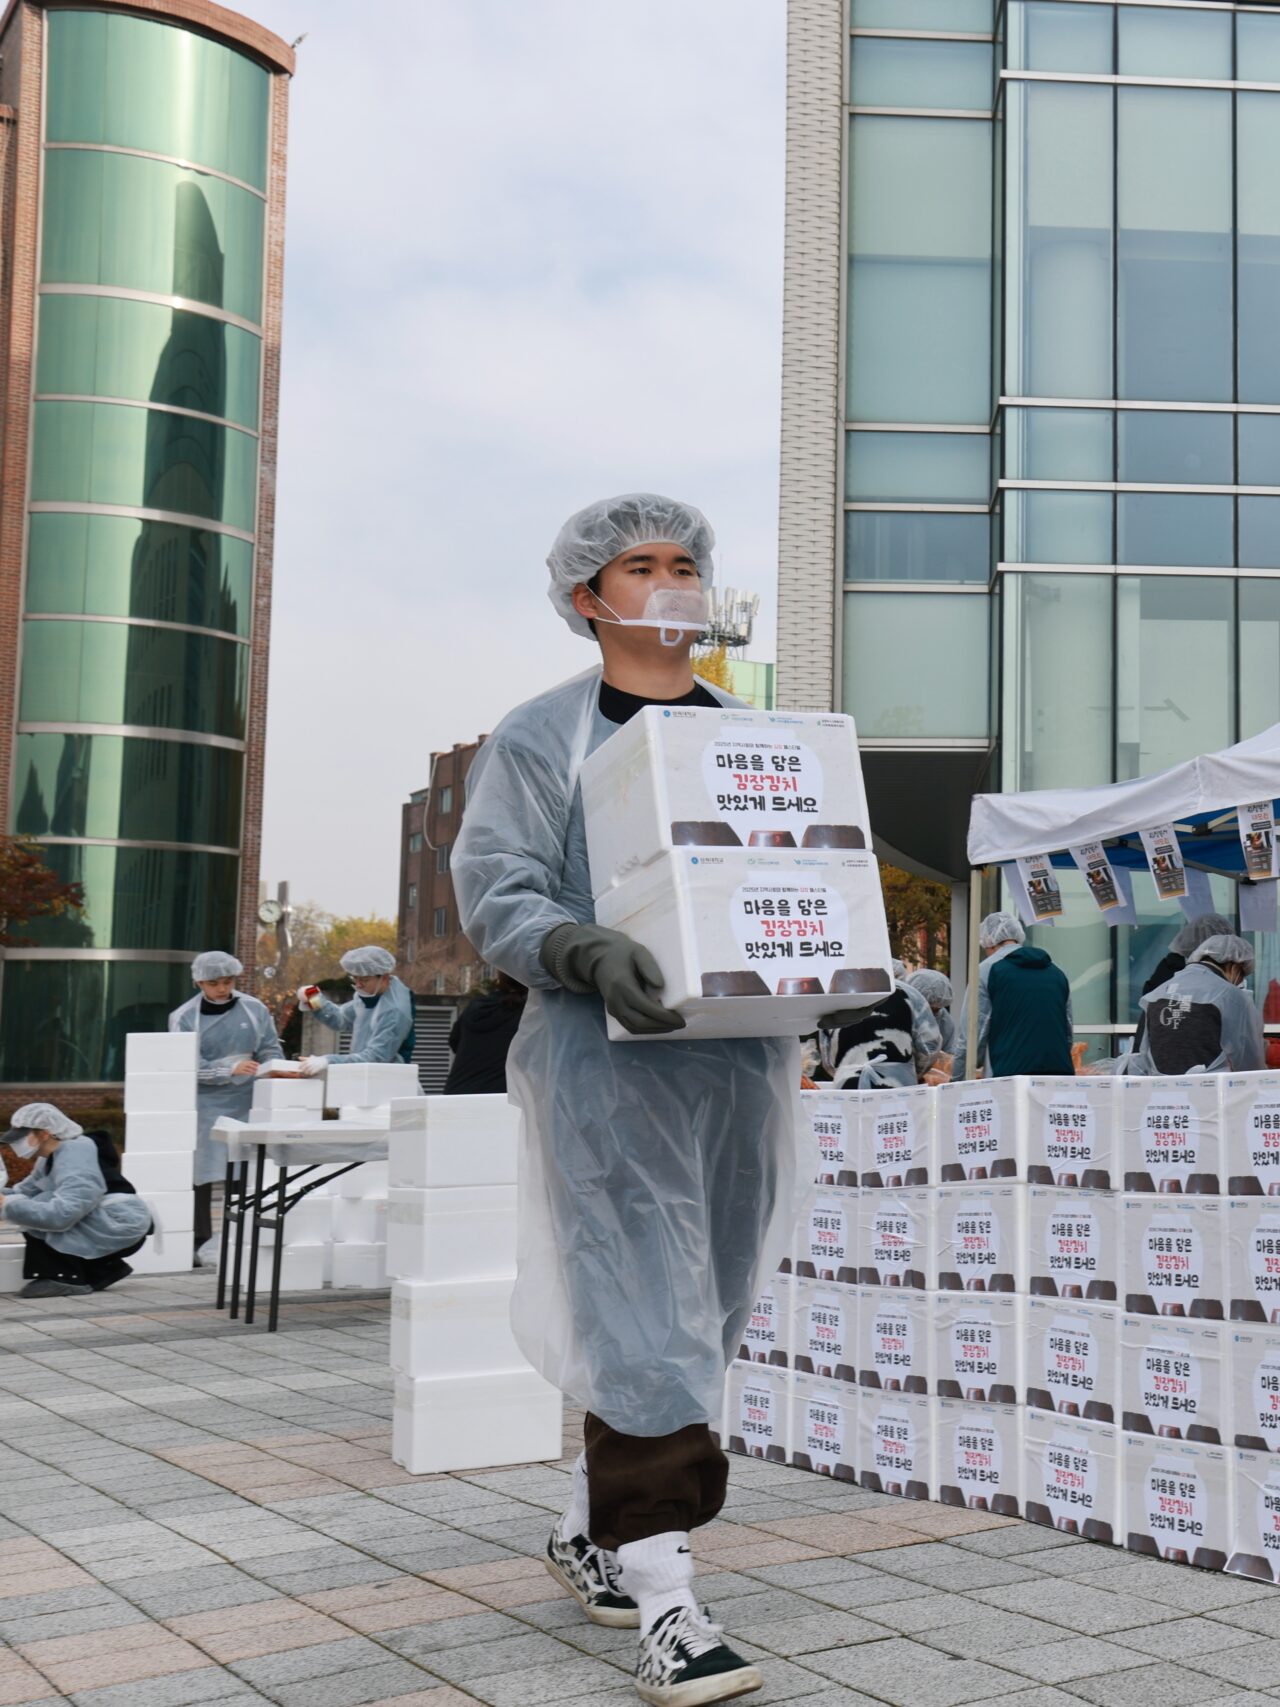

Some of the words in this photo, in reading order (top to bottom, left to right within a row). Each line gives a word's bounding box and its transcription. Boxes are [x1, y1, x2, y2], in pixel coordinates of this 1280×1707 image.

[718, 754, 763, 771] 마음을
[771, 755, 802, 771] 담은
[733, 775, 797, 792] 김장김치
[718, 794, 765, 811] 맛있게
[771, 797, 818, 813] 드세요
[745, 899, 790, 916] 마음을
[797, 898, 828, 915] 담은
[761, 920, 824, 937] 김장김치
[747, 941, 792, 958] 맛있게
[799, 941, 844, 957] 드세요
[1255, 1114, 1280, 1129] 마음을
[1253, 1151, 1279, 1166] 맛있게
[1149, 1238, 1172, 1252] 마음을
[1176, 1238, 1192, 1252] 담은
[1156, 1255, 1188, 1269] 김장김치
[1148, 1272, 1171, 1286] 맛있게
[1175, 1274, 1199, 1288] 드세요
